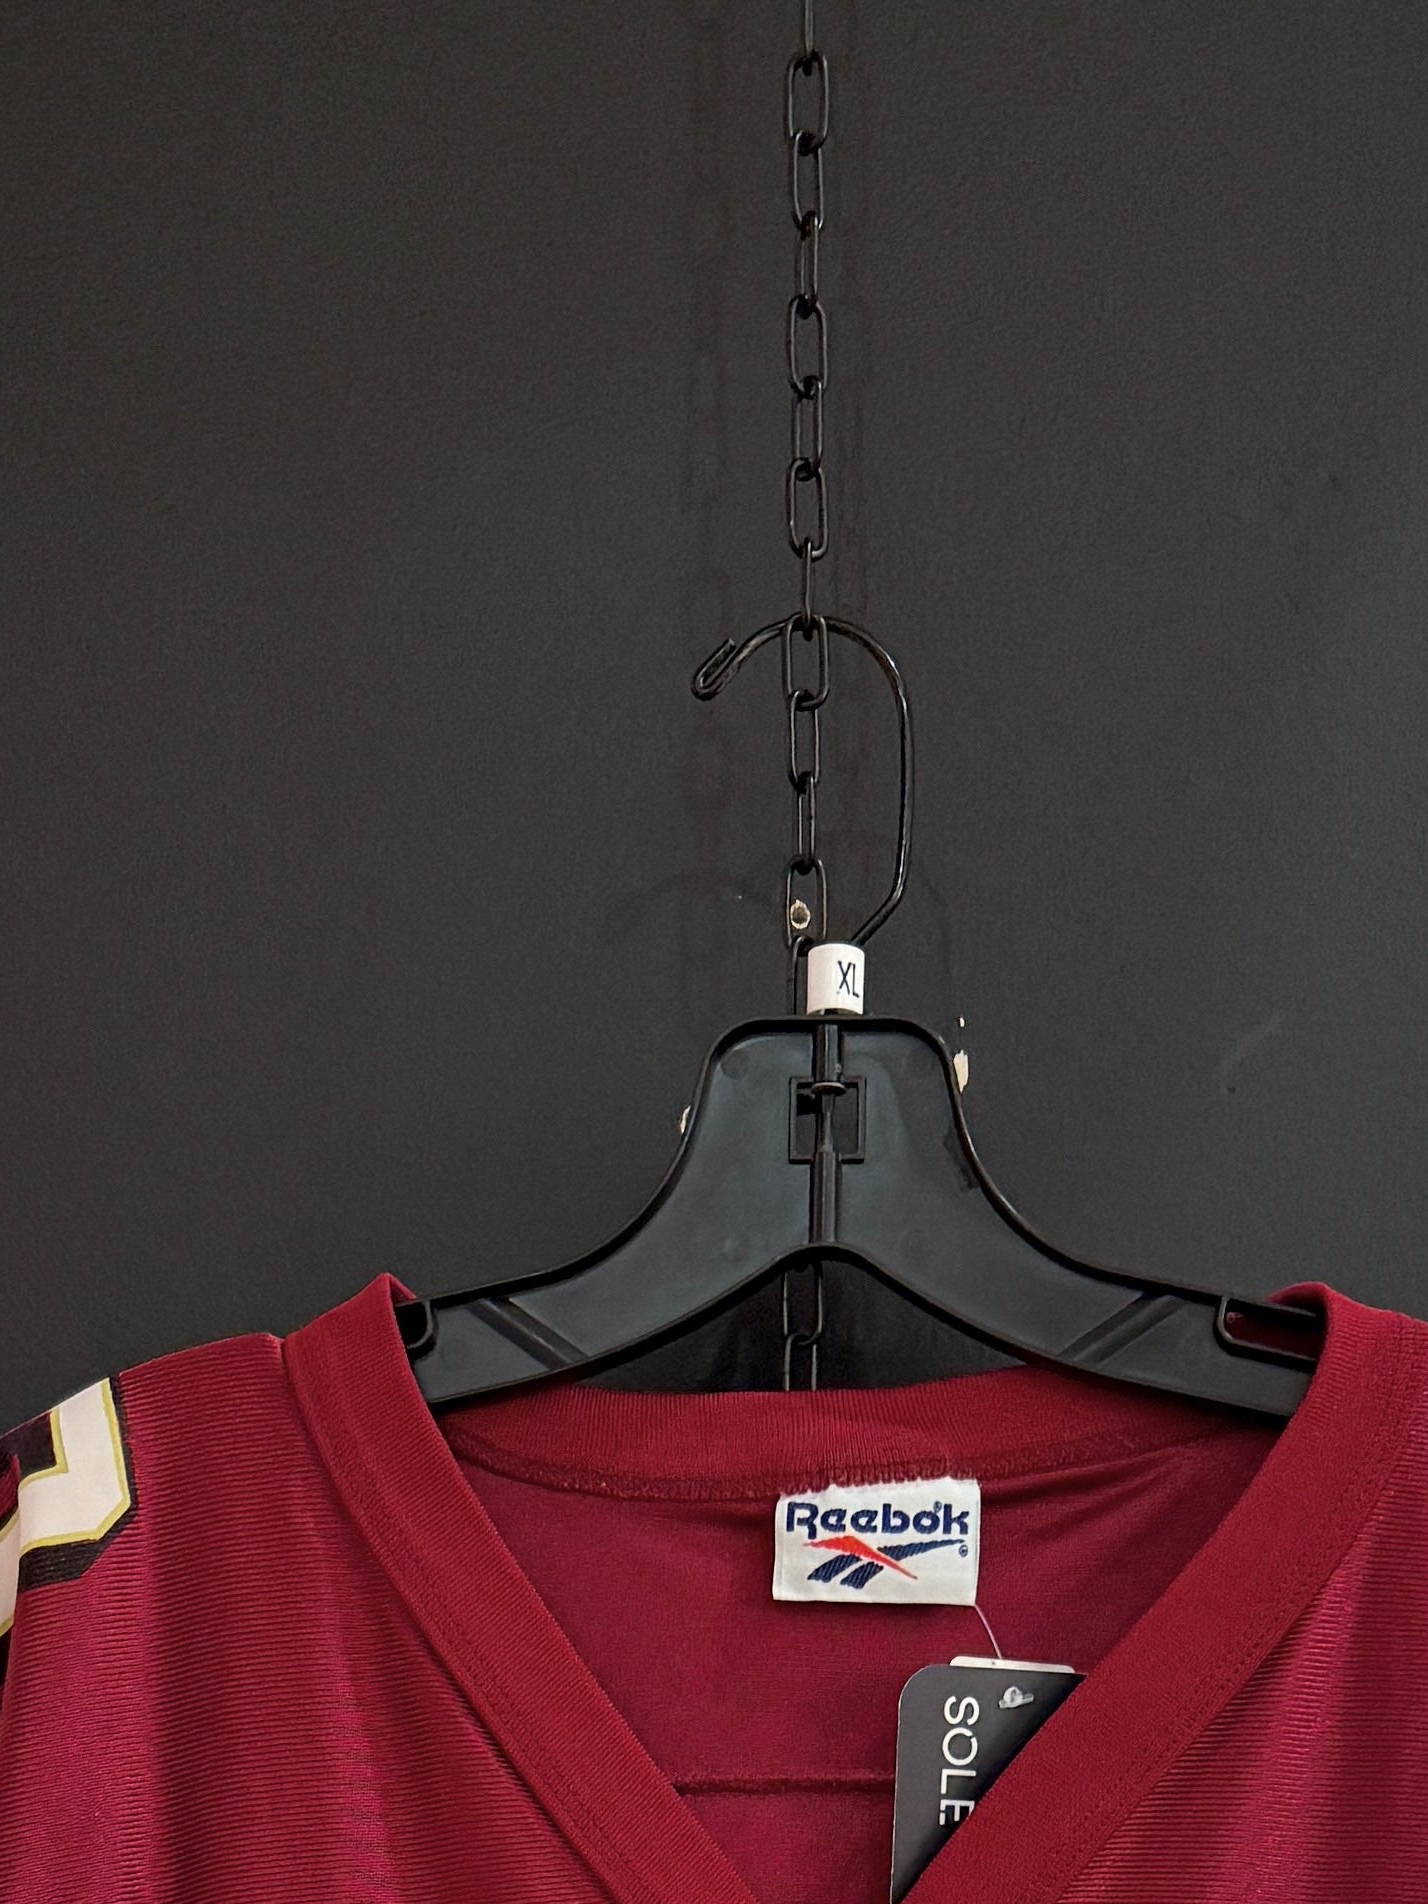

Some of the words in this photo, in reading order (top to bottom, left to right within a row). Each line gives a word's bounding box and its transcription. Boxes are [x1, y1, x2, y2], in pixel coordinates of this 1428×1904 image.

[837, 960, 860, 998] XL
[785, 1501, 970, 1541] Reebok
[938, 1695, 981, 1826] SOLE
